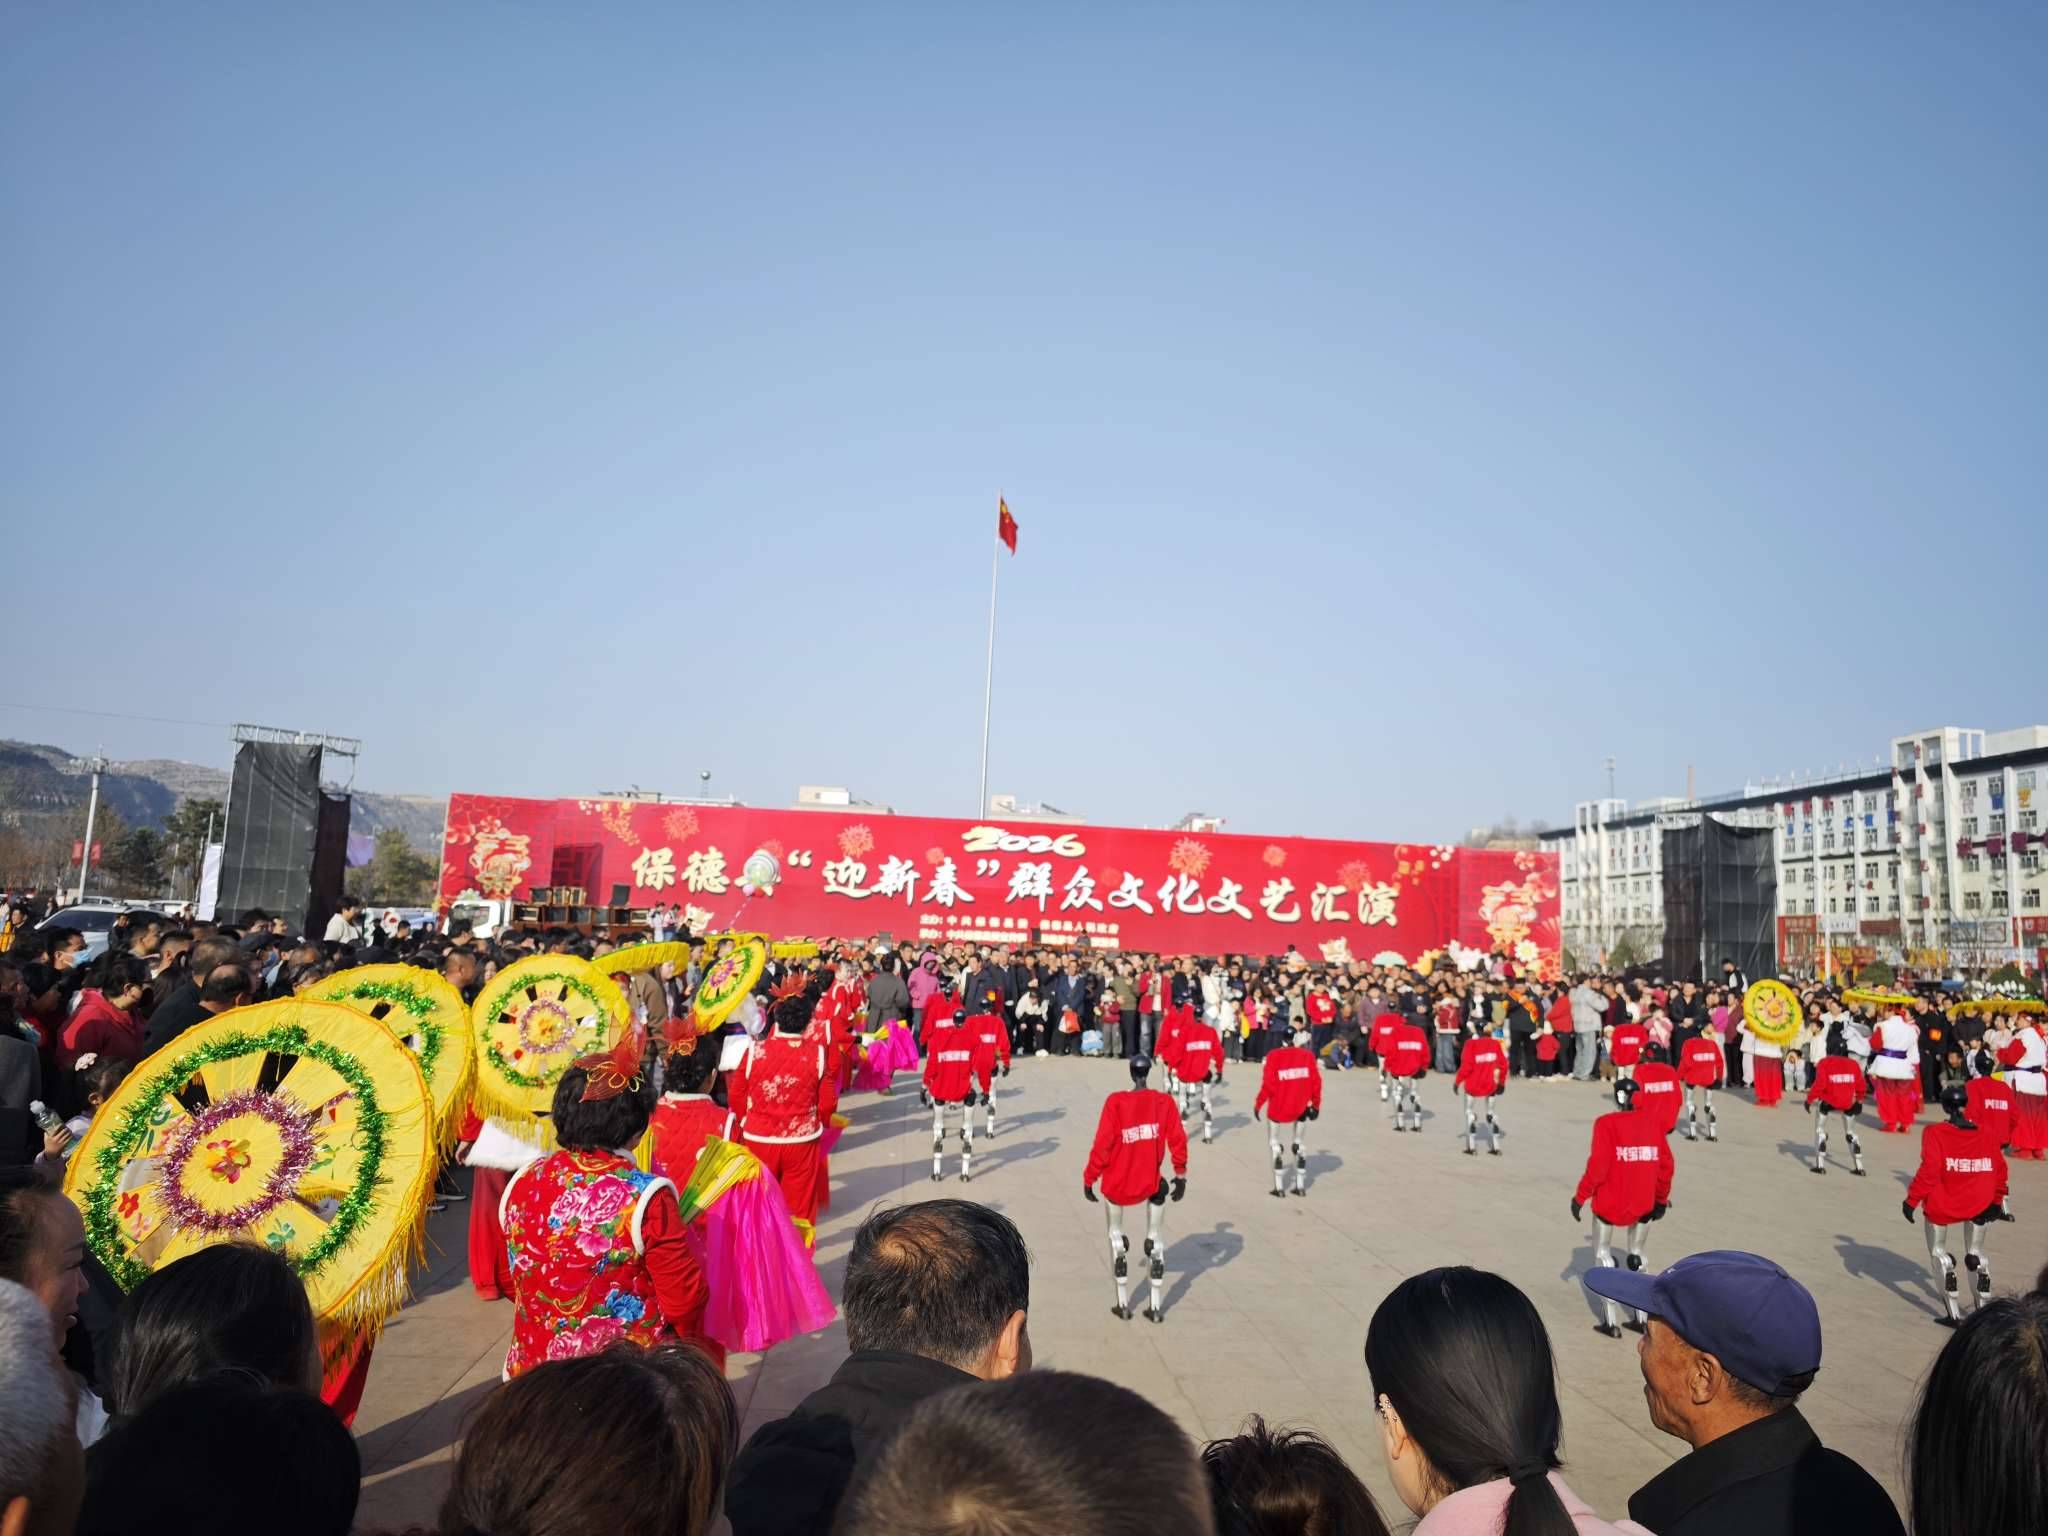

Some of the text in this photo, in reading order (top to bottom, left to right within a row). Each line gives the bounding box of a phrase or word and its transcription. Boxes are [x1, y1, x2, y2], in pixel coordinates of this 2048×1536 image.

[960, 826, 1086, 858] 2026
[631, 846, 1400, 927] 保德“迎新春”群众文化文艺汇演
[1945, 1157, 1993, 1172] 兴宝酒业
